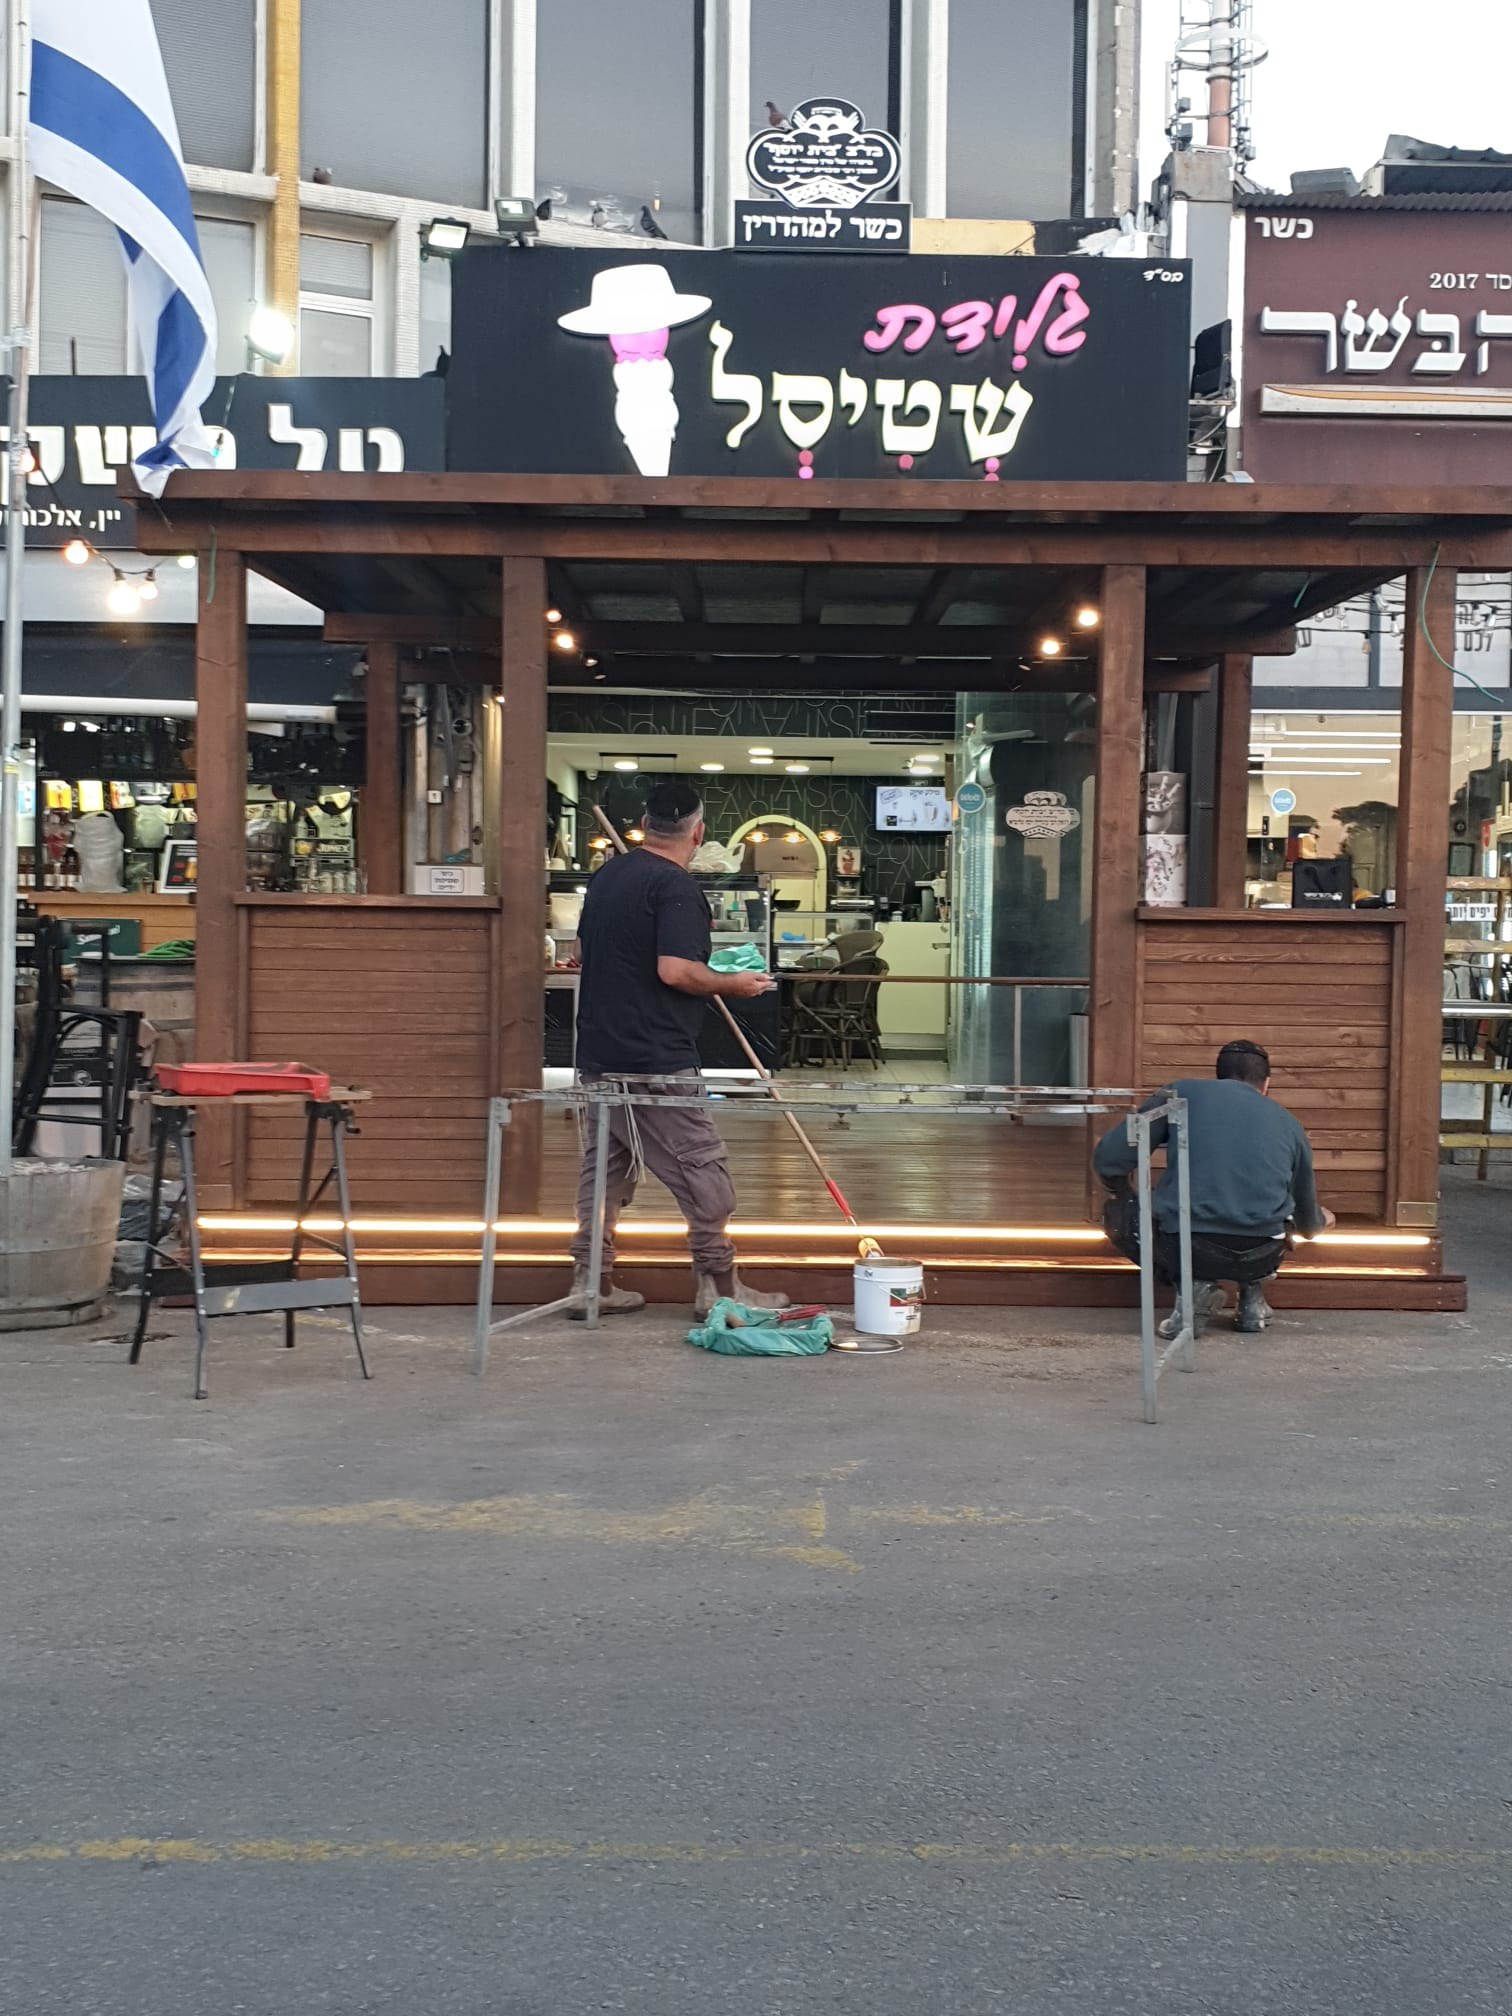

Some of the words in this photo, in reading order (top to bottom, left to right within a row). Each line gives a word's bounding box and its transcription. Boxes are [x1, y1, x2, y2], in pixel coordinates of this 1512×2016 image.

[742, 209, 842, 242] למהדרין
[850, 216, 903, 240] כשר
[1254, 216, 1314, 239] כשר
[1429, 273, 1480, 289] 2017
[863, 272, 1090, 371] גלידת
